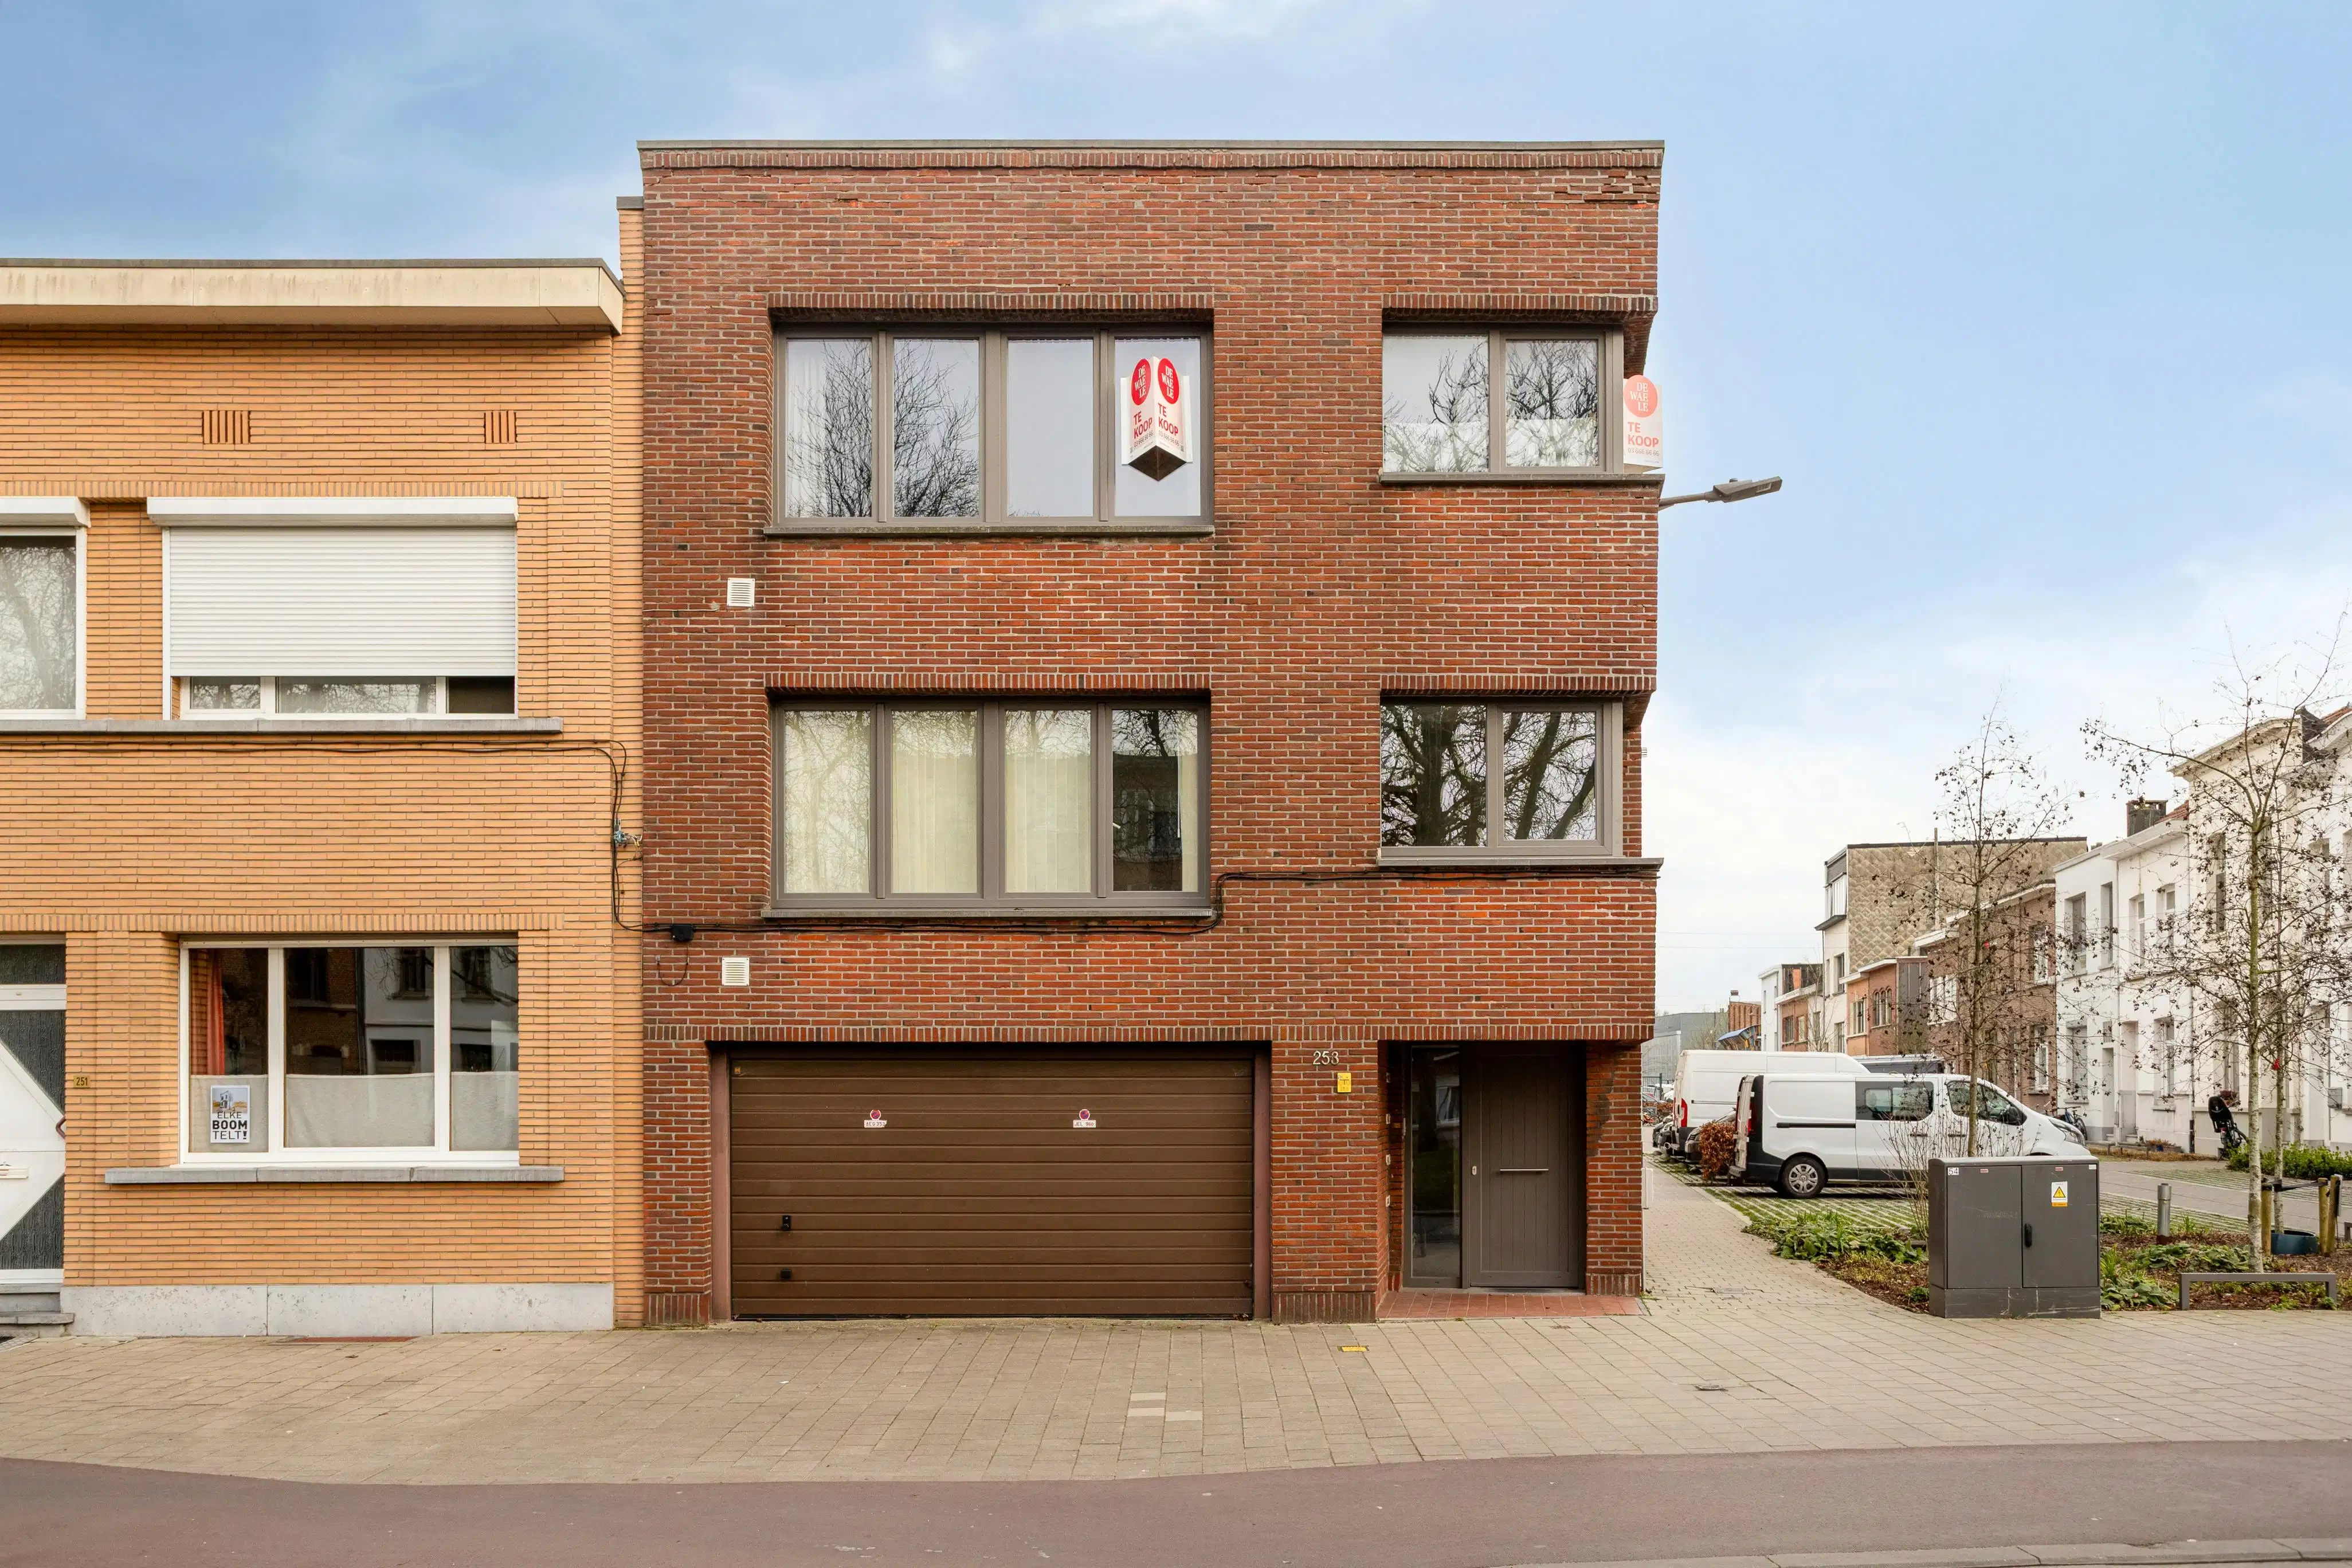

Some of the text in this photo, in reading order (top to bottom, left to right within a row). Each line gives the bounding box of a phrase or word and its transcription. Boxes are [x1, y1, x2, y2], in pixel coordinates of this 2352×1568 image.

[1138, 364, 1146, 378] DE
[1165, 365, 1173, 379] DE
[1135, 375, 1146, 391] WAE
[1162, 373, 1174, 389] WAE
[1636, 382, 1648, 393] DE
[1139, 385, 1146, 399] LE
[1167, 386, 1174, 399] LE
[1629, 390, 1648, 402] WAE
[1158, 402, 1167, 417] TE
[1637, 401, 1648, 412] LE
[1134, 411, 1142, 425] TE
[1134, 417, 1153, 439] KOOP
[1158, 417, 1178, 436] KOOP
[1627, 421, 1641, 433] TE
[1628, 434, 1659, 448] KOOP
[1312, 1050, 1339, 1065] 253
[76, 1077, 88, 1086] 251
[212, 1120, 248, 1130] BOOM
[213, 1131, 247, 1140] TELT!
